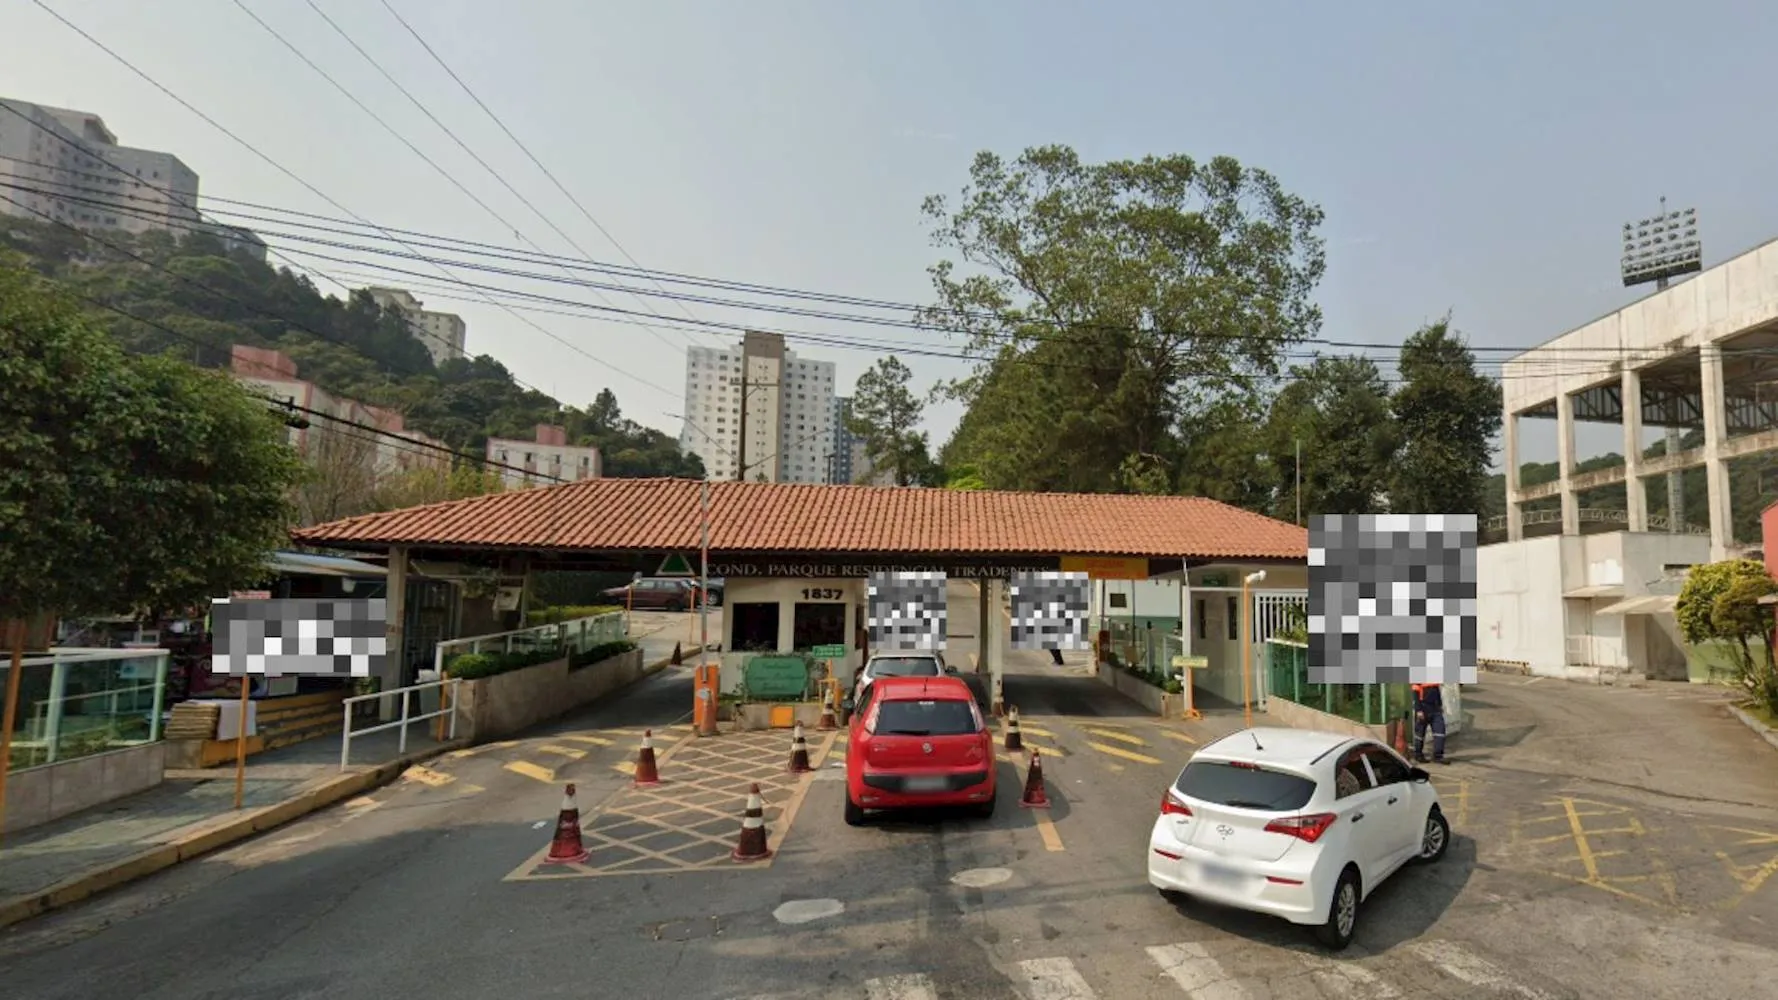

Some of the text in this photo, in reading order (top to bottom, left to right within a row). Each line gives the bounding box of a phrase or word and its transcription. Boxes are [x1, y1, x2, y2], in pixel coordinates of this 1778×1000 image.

[706, 563, 762, 576] COND.
[768, 564, 836, 577] PARQUE
[801, 588, 843, 600] 1837
